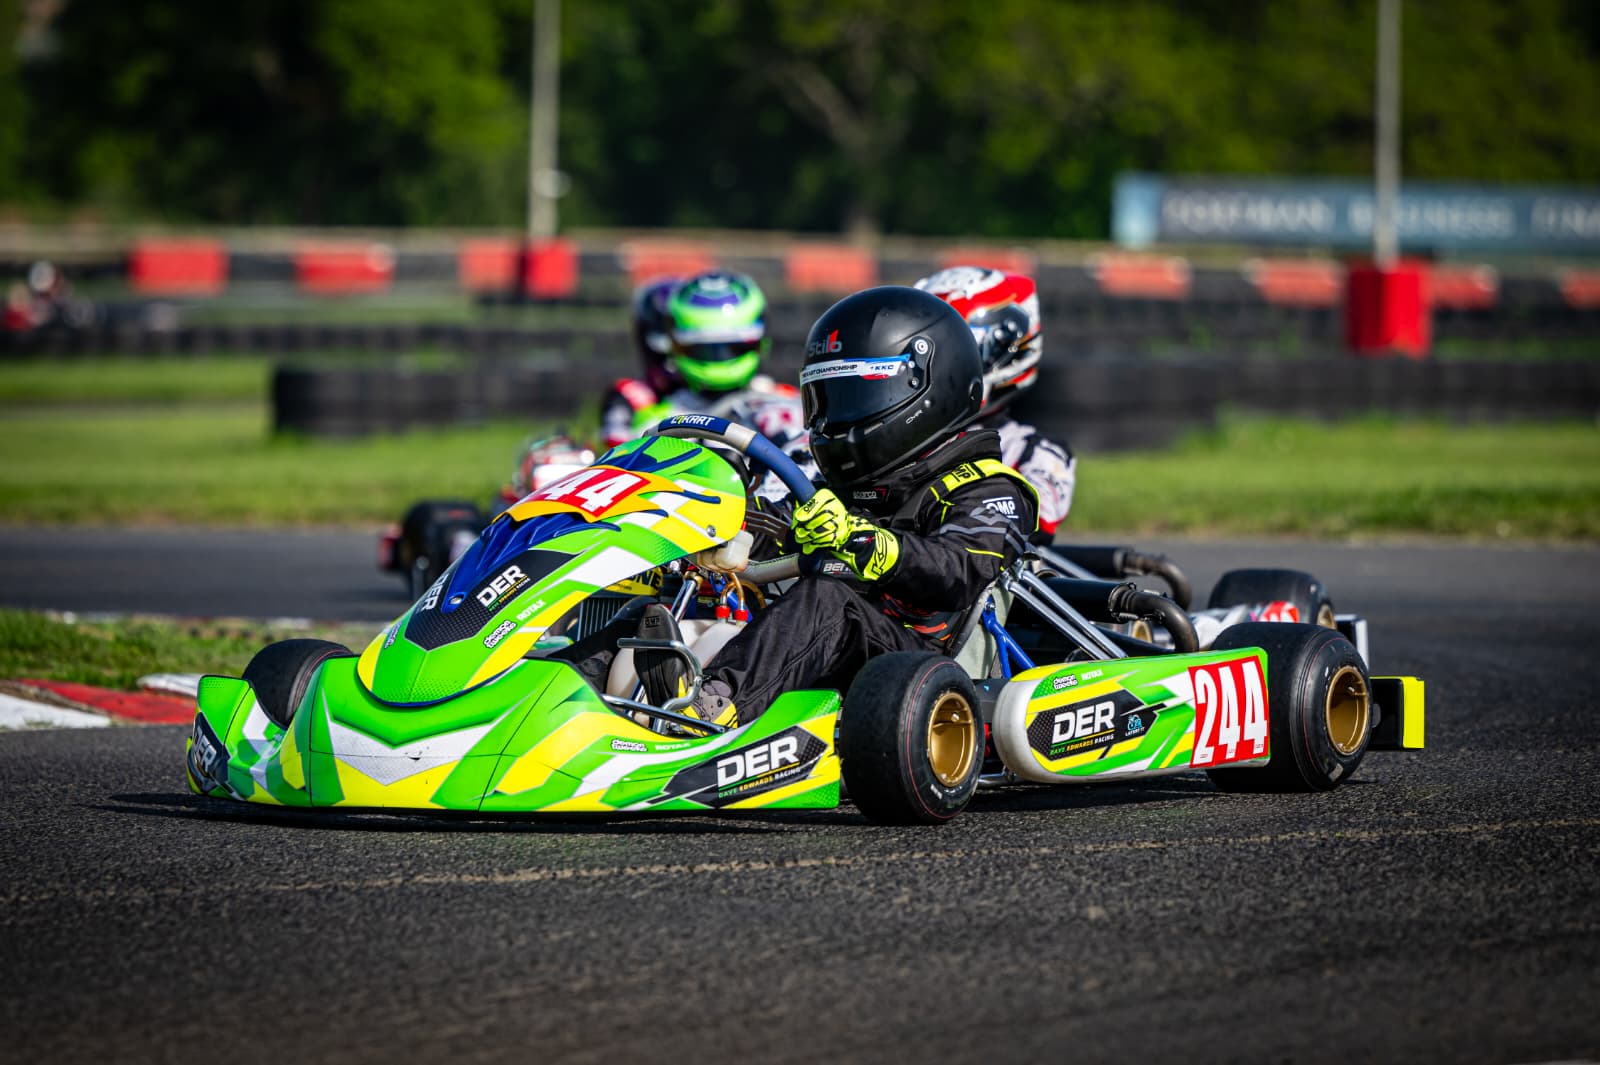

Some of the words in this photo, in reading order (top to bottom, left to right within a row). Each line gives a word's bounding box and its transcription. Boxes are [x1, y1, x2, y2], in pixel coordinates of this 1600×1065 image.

[476, 565, 526, 606] DER
[516, 599, 546, 621] ROTAX
[1052, 701, 1114, 744] DER
[1192, 660, 1267, 764] 244
[1094, 733, 1114, 744] RACING
[717, 735, 799, 788] DER
[739, 775, 774, 792] EDWARDS
[774, 766, 801, 779] RACING
